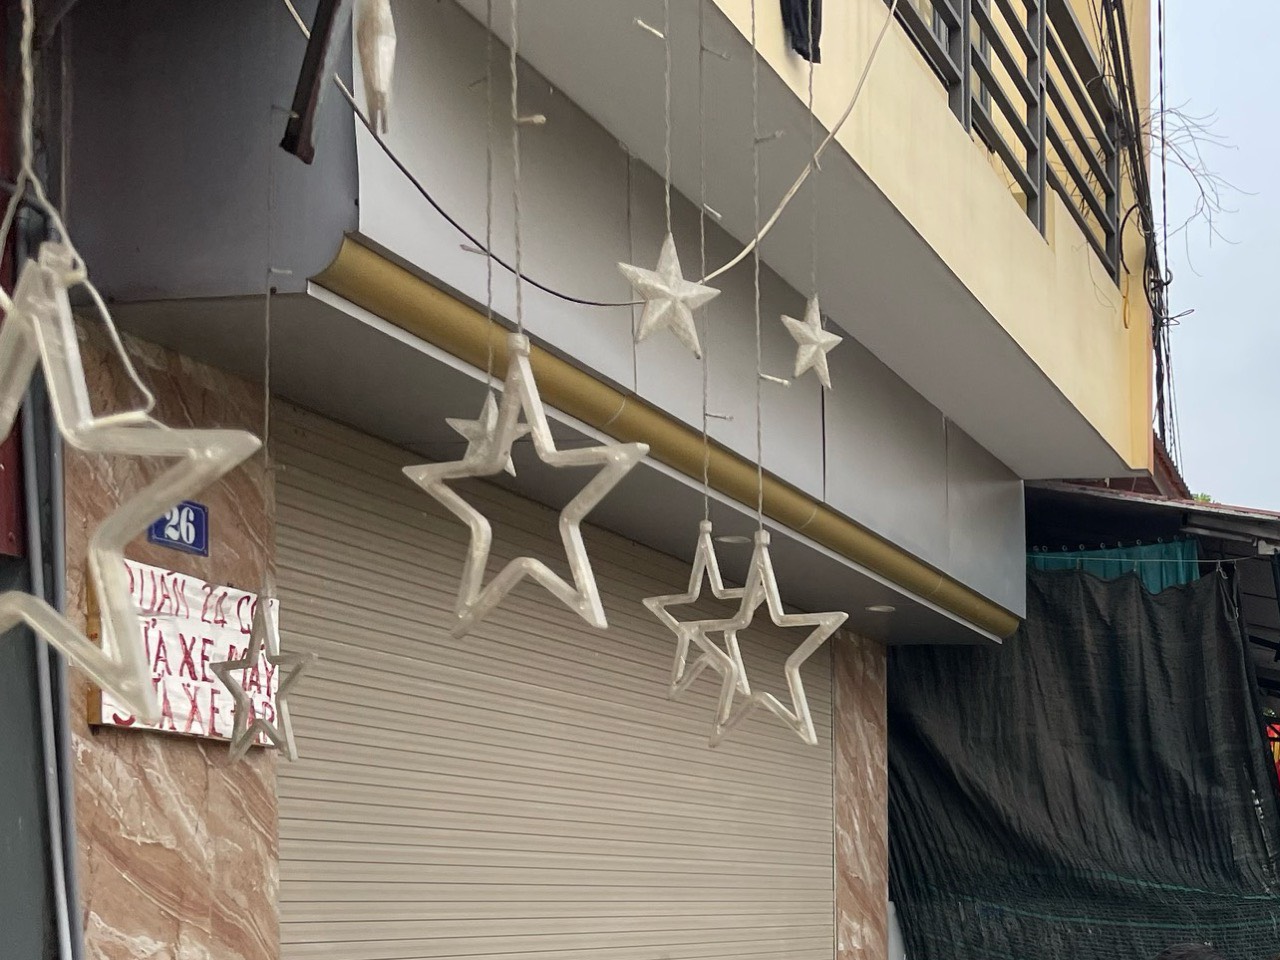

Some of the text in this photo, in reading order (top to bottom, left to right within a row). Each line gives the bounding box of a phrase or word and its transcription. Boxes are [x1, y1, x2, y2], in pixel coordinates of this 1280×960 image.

[165, 506, 196, 545] 26
[179, 633, 215, 683] XE
[182, 682, 223, 737] XE
